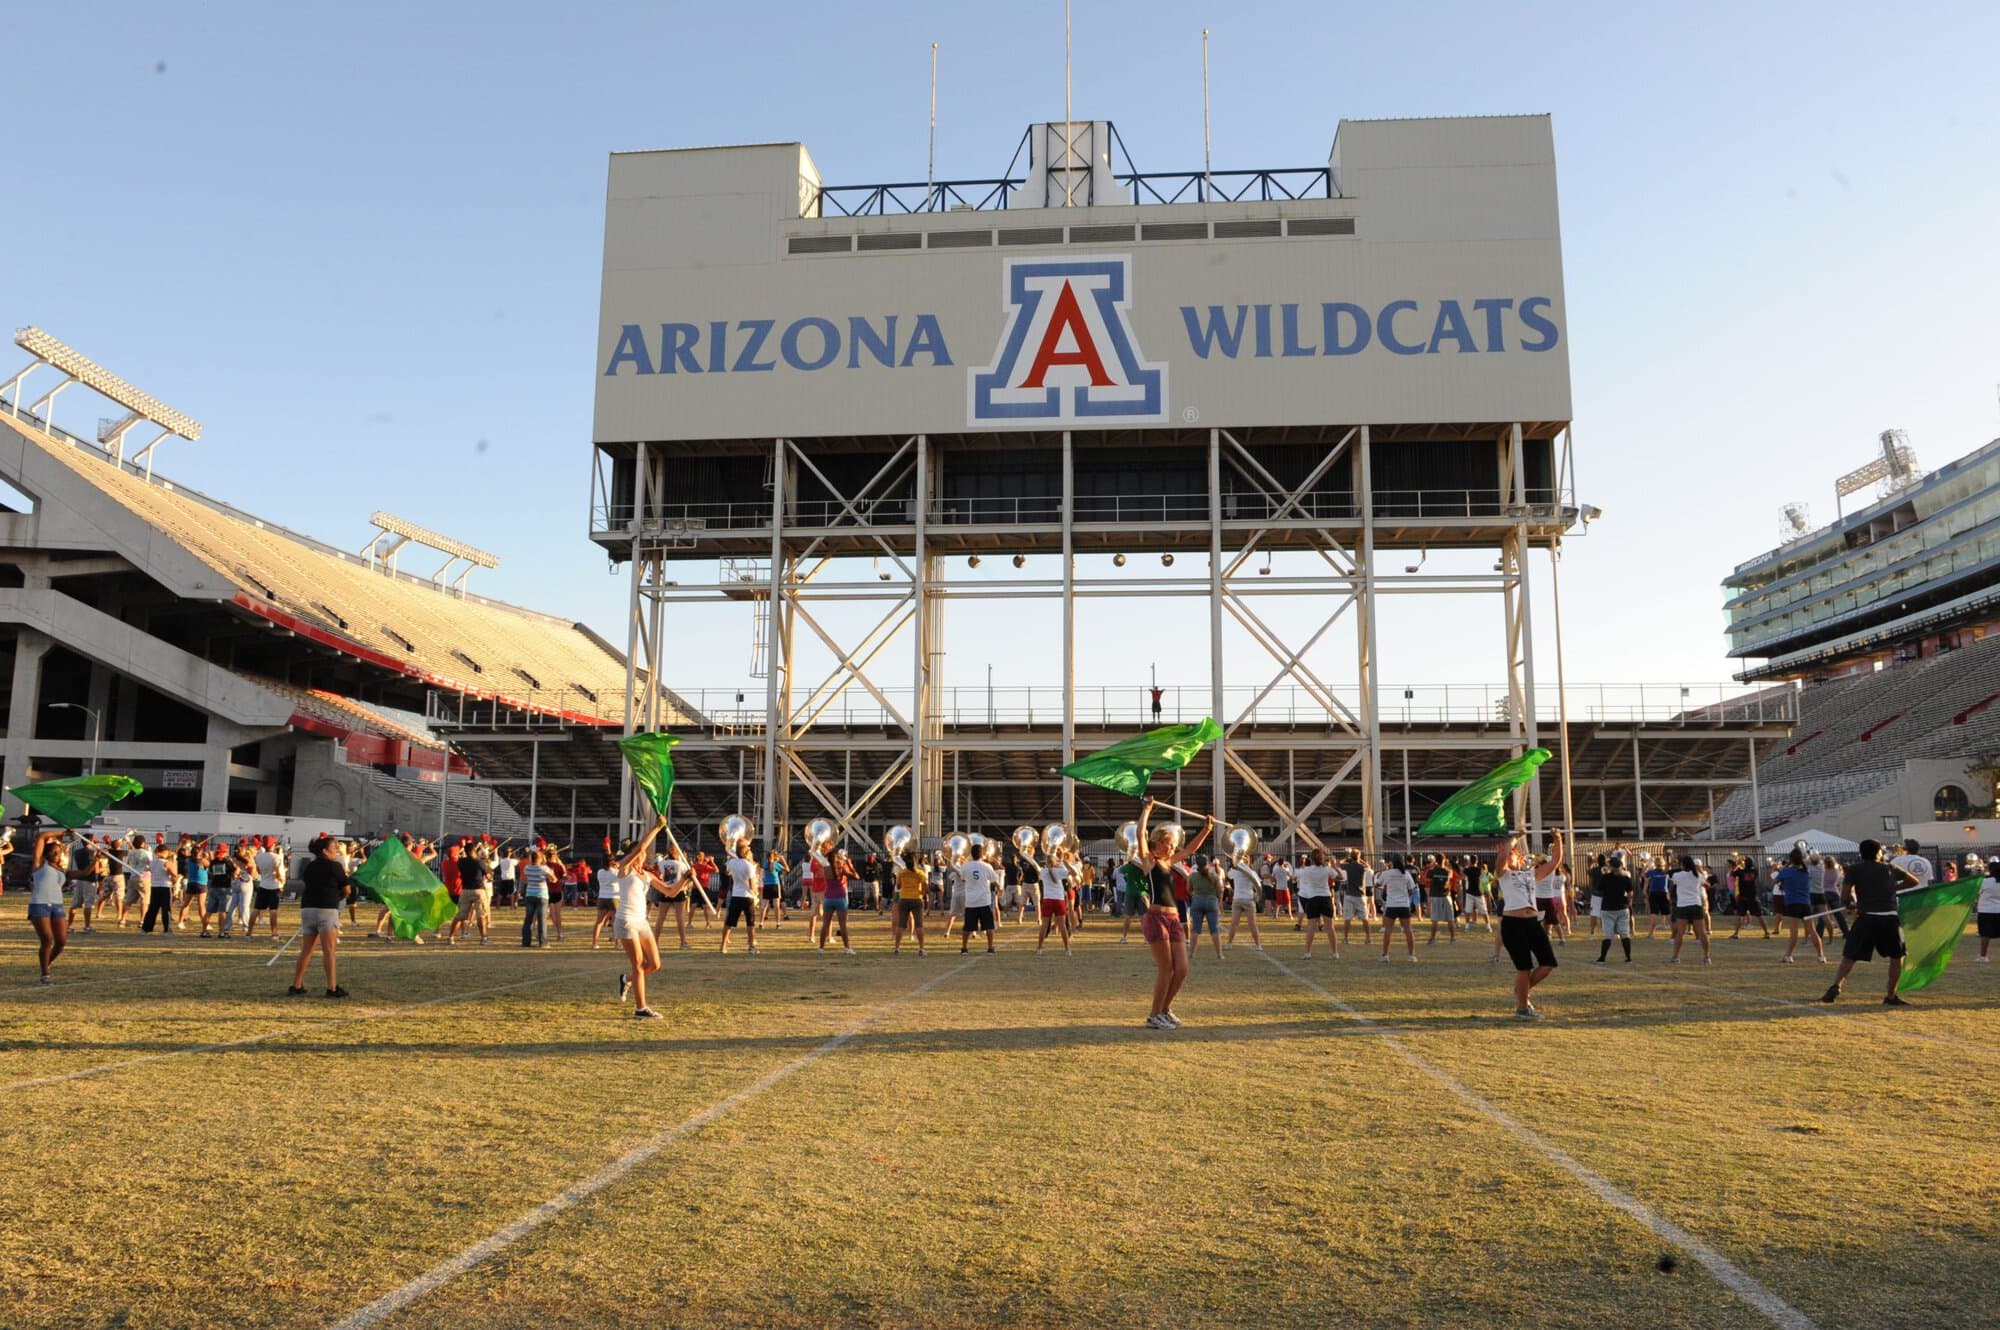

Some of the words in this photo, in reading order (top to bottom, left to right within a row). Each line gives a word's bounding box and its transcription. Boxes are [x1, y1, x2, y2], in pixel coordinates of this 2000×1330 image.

[603, 314, 955, 377] ARIZONA
[968, 254, 1168, 426] A
[1179, 296, 1559, 359] WILDCATS
[972, 870, 980, 880] 5
